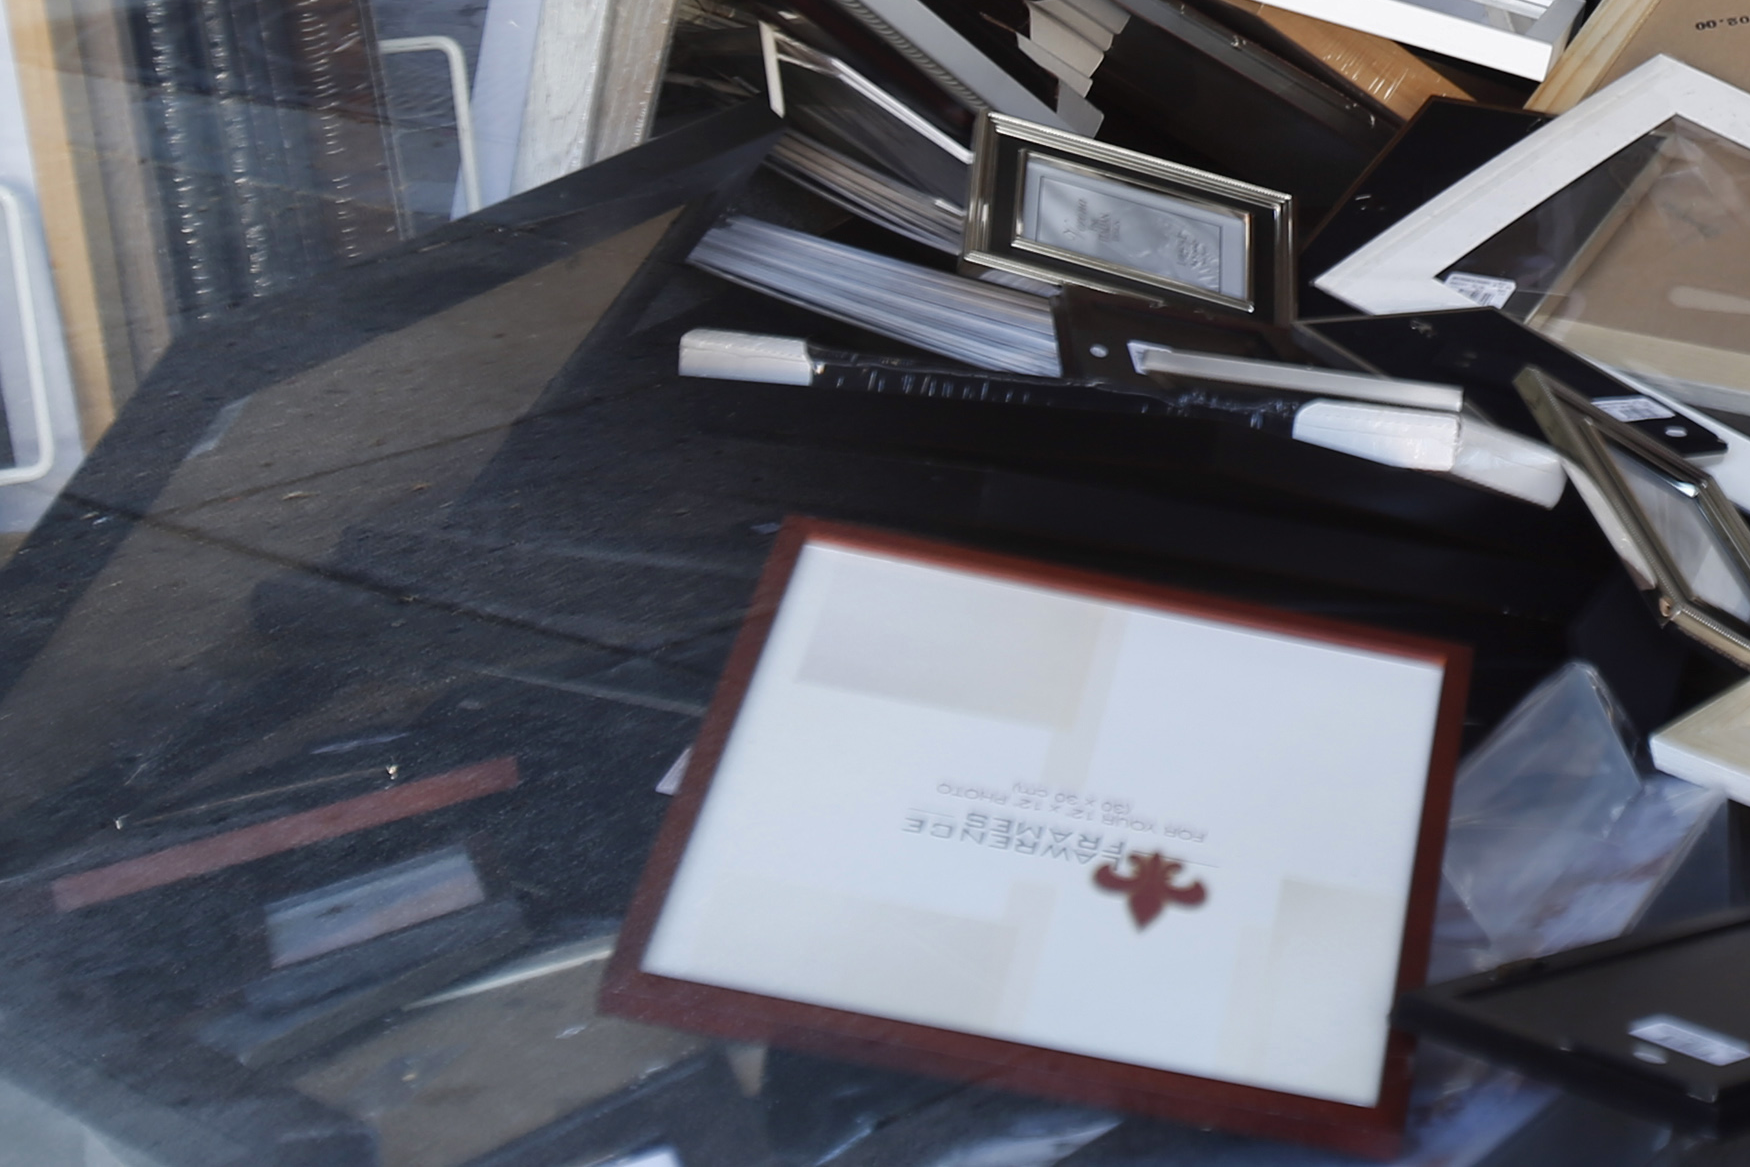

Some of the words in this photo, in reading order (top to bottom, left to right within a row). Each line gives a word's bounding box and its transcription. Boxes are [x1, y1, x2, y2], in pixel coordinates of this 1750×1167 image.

[936, 782, 1010, 806] PHOTO
[1054, 791, 1081, 807] 30
[1102, 807, 1154, 833] YOUR
[902, 816, 1119, 871] LAWRENCE
[965, 812, 1127, 856] FRAMES
[1163, 825, 1206, 844] FOR
